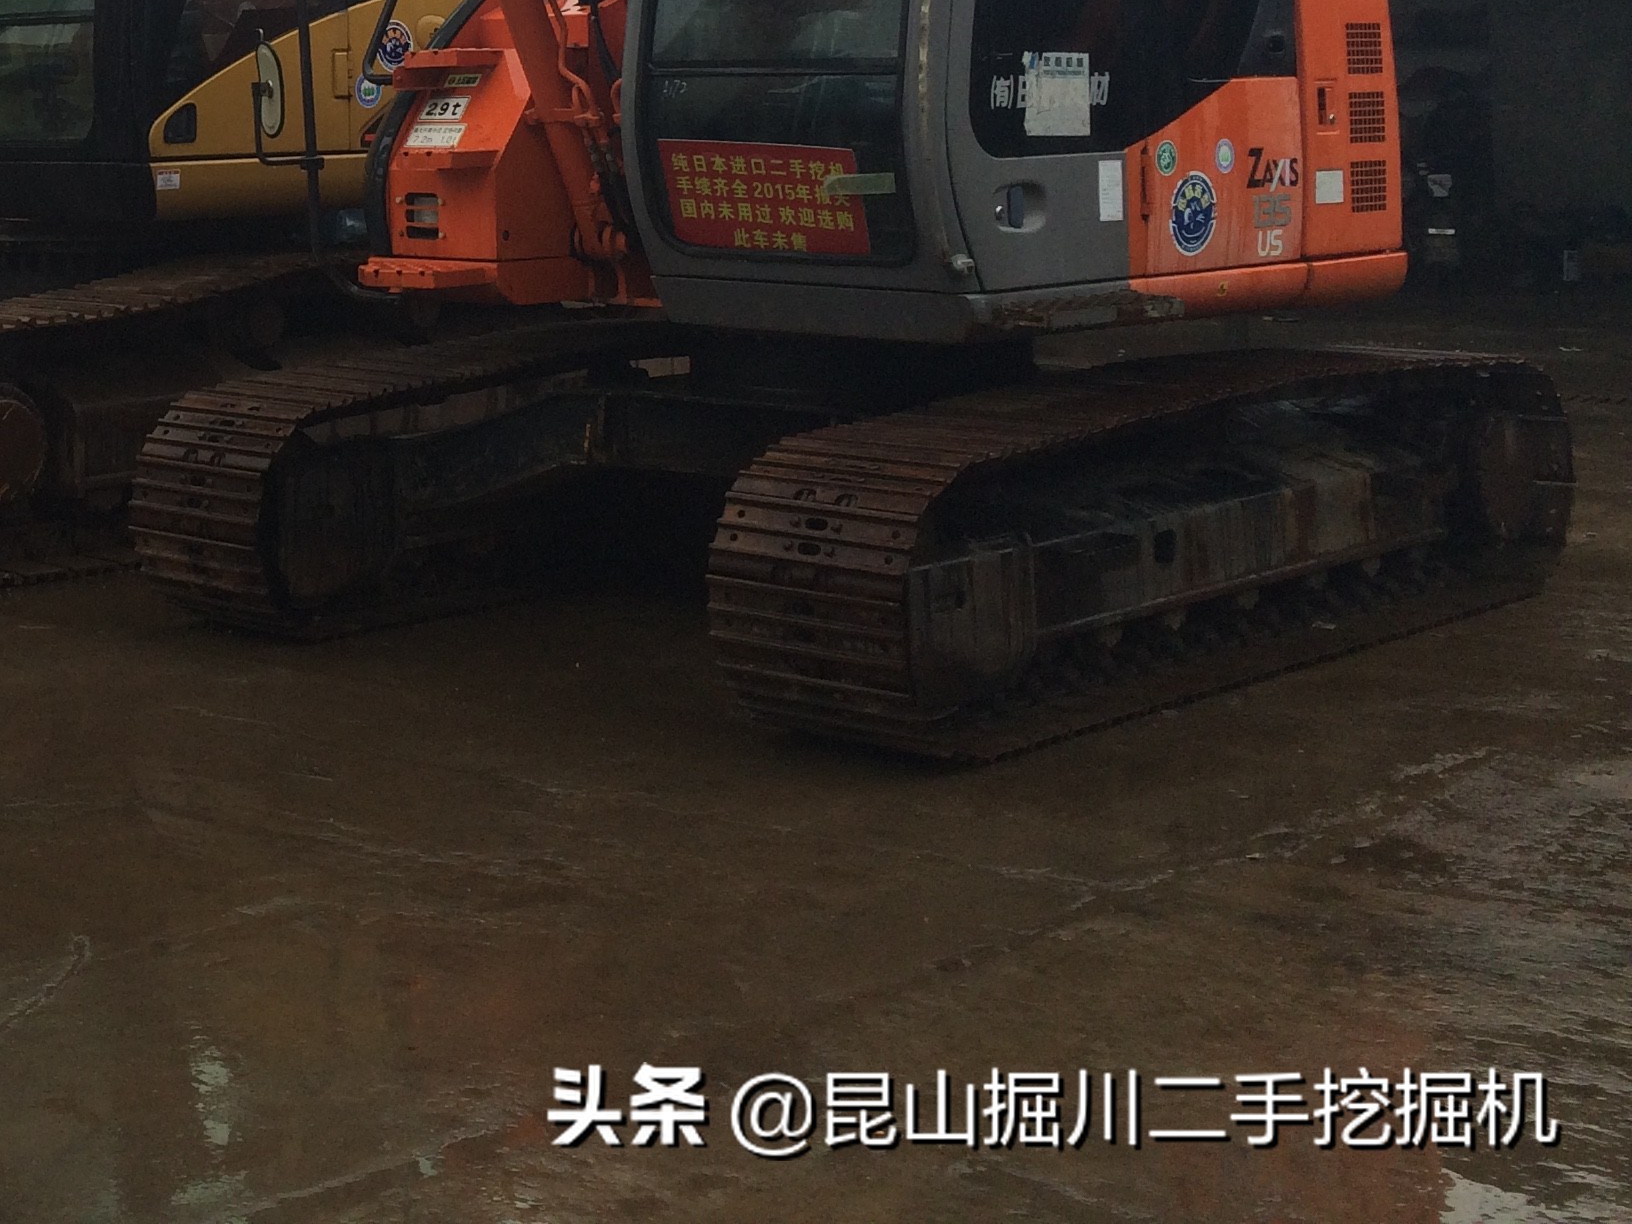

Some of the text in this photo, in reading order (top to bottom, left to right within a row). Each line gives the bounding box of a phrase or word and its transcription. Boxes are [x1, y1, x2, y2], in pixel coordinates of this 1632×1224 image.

[672, 152, 843, 180] 纯日本进口二手挖机
[676, 176, 748, 199] 手续齐全
[680, 199, 855, 232] 国内未用过 欢迎选购
[1257, 229, 1283, 257] US
